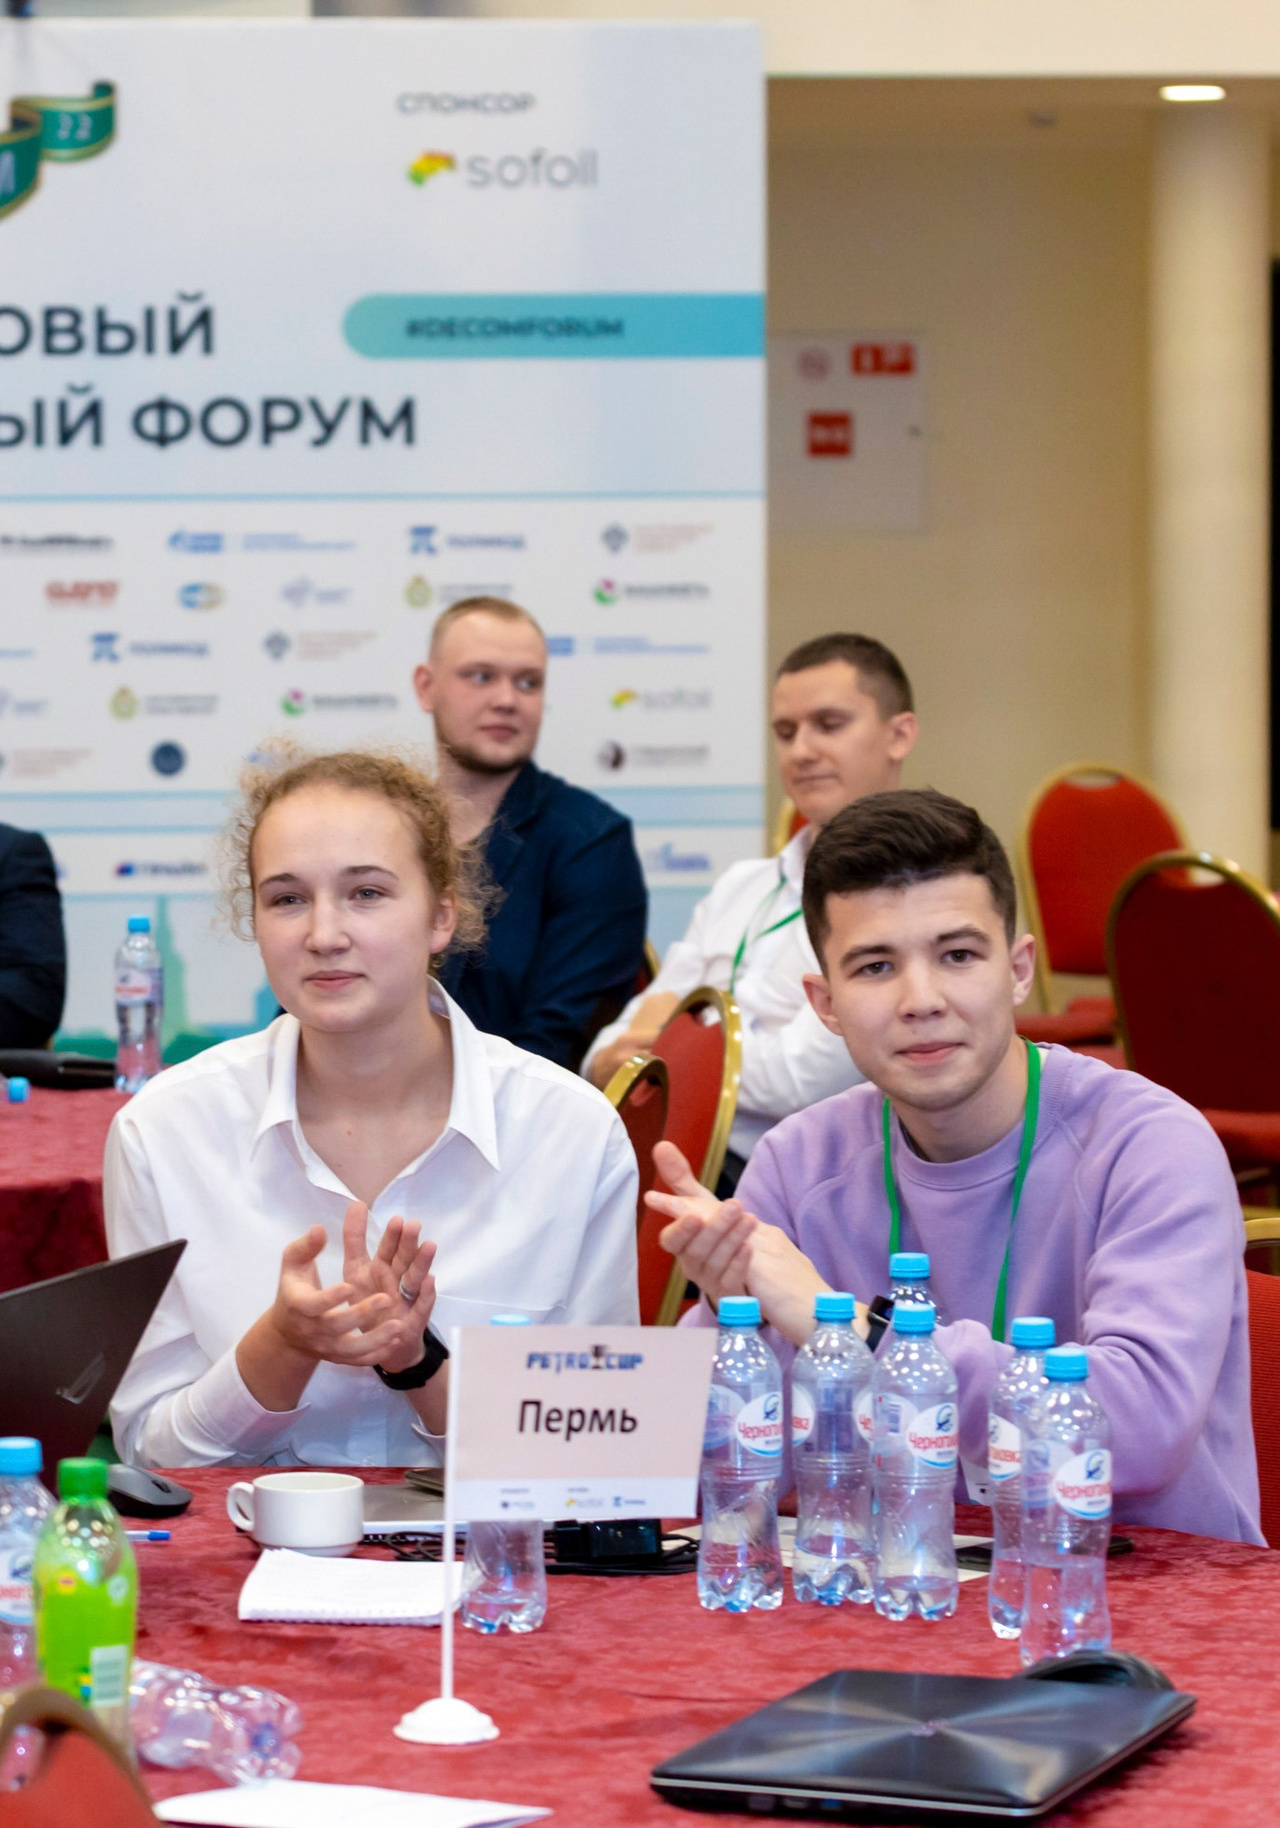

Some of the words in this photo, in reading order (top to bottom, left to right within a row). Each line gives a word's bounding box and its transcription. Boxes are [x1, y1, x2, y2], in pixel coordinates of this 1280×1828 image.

[395, 92, 536, 114] СПОНСОР
[405, 316, 625, 340] #DECOMFORUM
[131, 393, 417, 450] ФОРУМ
[519, 1399, 638, 1442] Пермь
